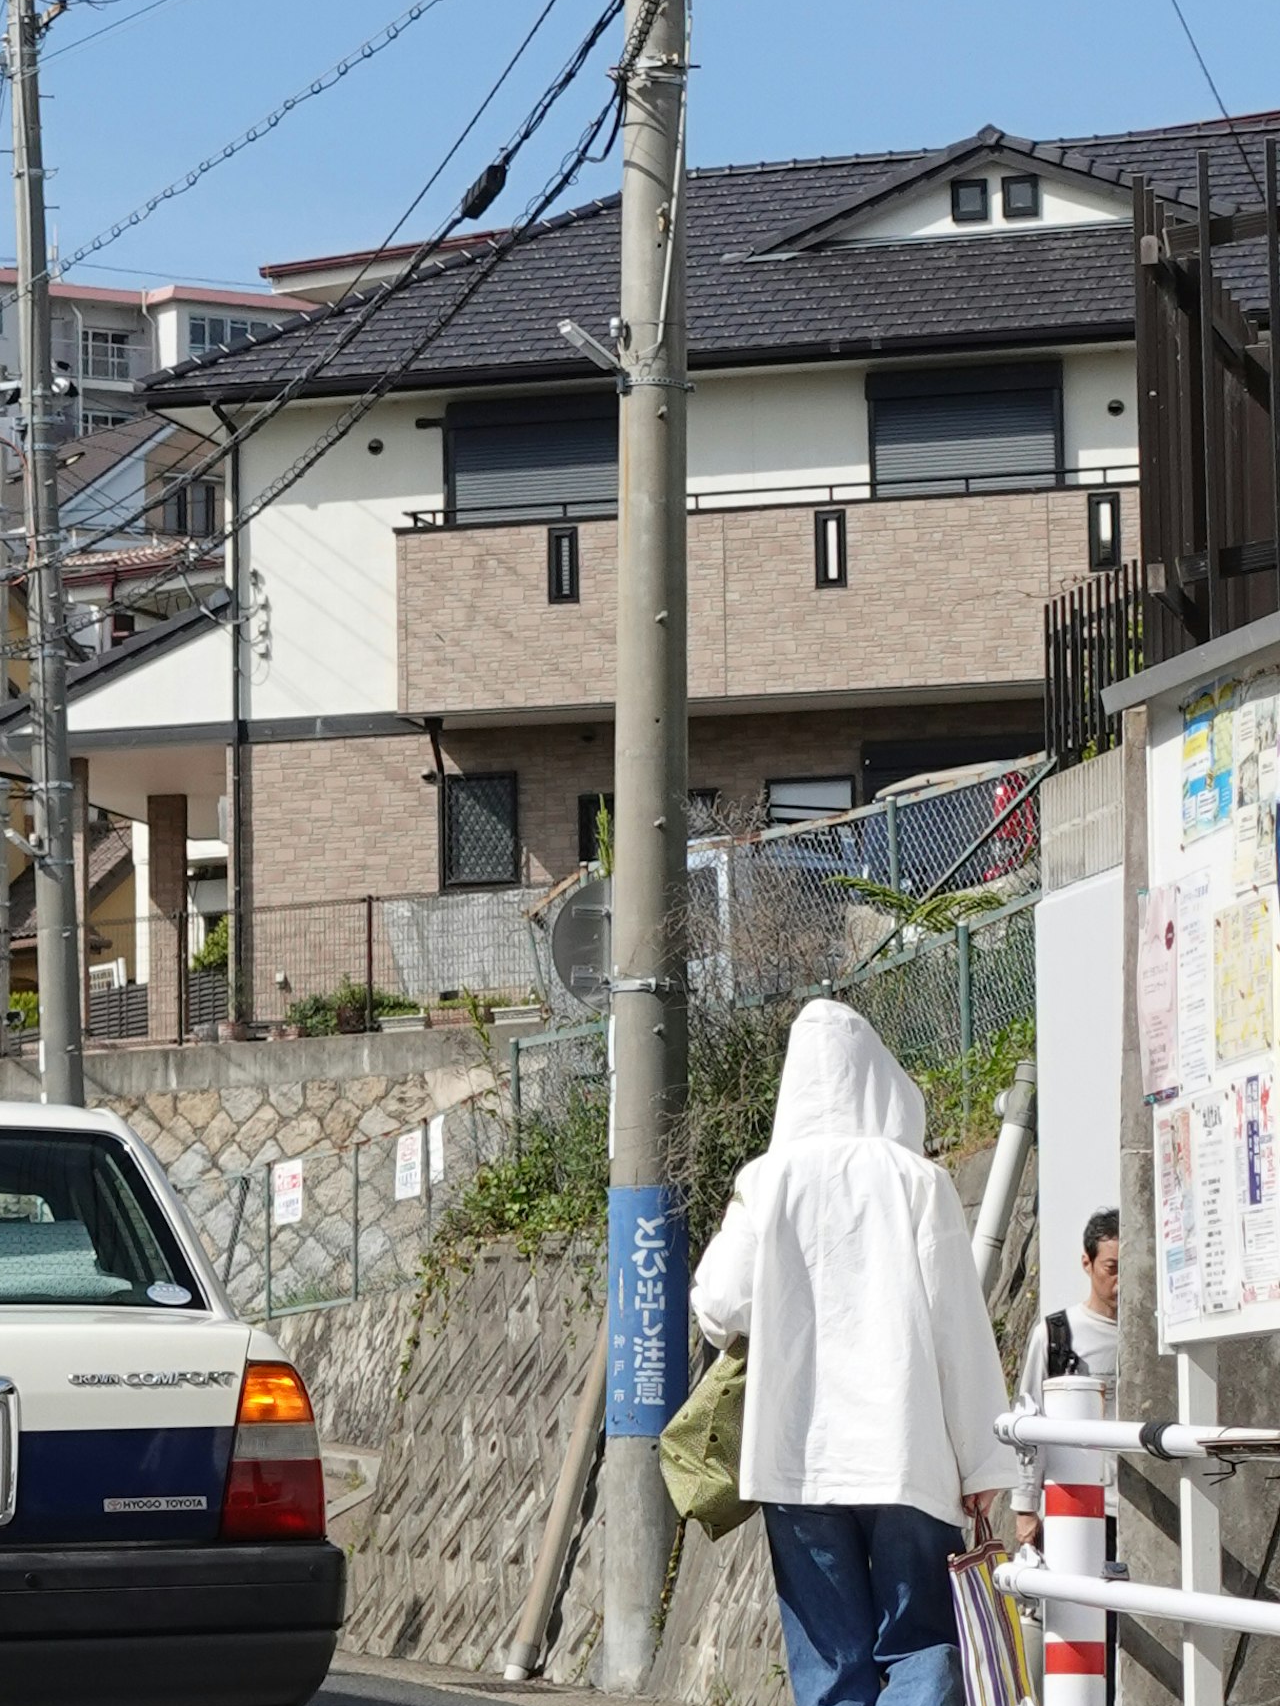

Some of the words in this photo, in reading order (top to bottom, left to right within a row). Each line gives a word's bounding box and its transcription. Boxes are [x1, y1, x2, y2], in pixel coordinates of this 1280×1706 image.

[631, 1217, 669, 1406] とび出し注意
[68, 1373, 120, 1387] CROWN
[122, 1371, 239, 1389] COMFORT
[613, 1334, 626, 1403] 神戸市
[123, 1500, 162, 1510] HYOGO
[165, 1498, 203, 1508] TOYOTA
